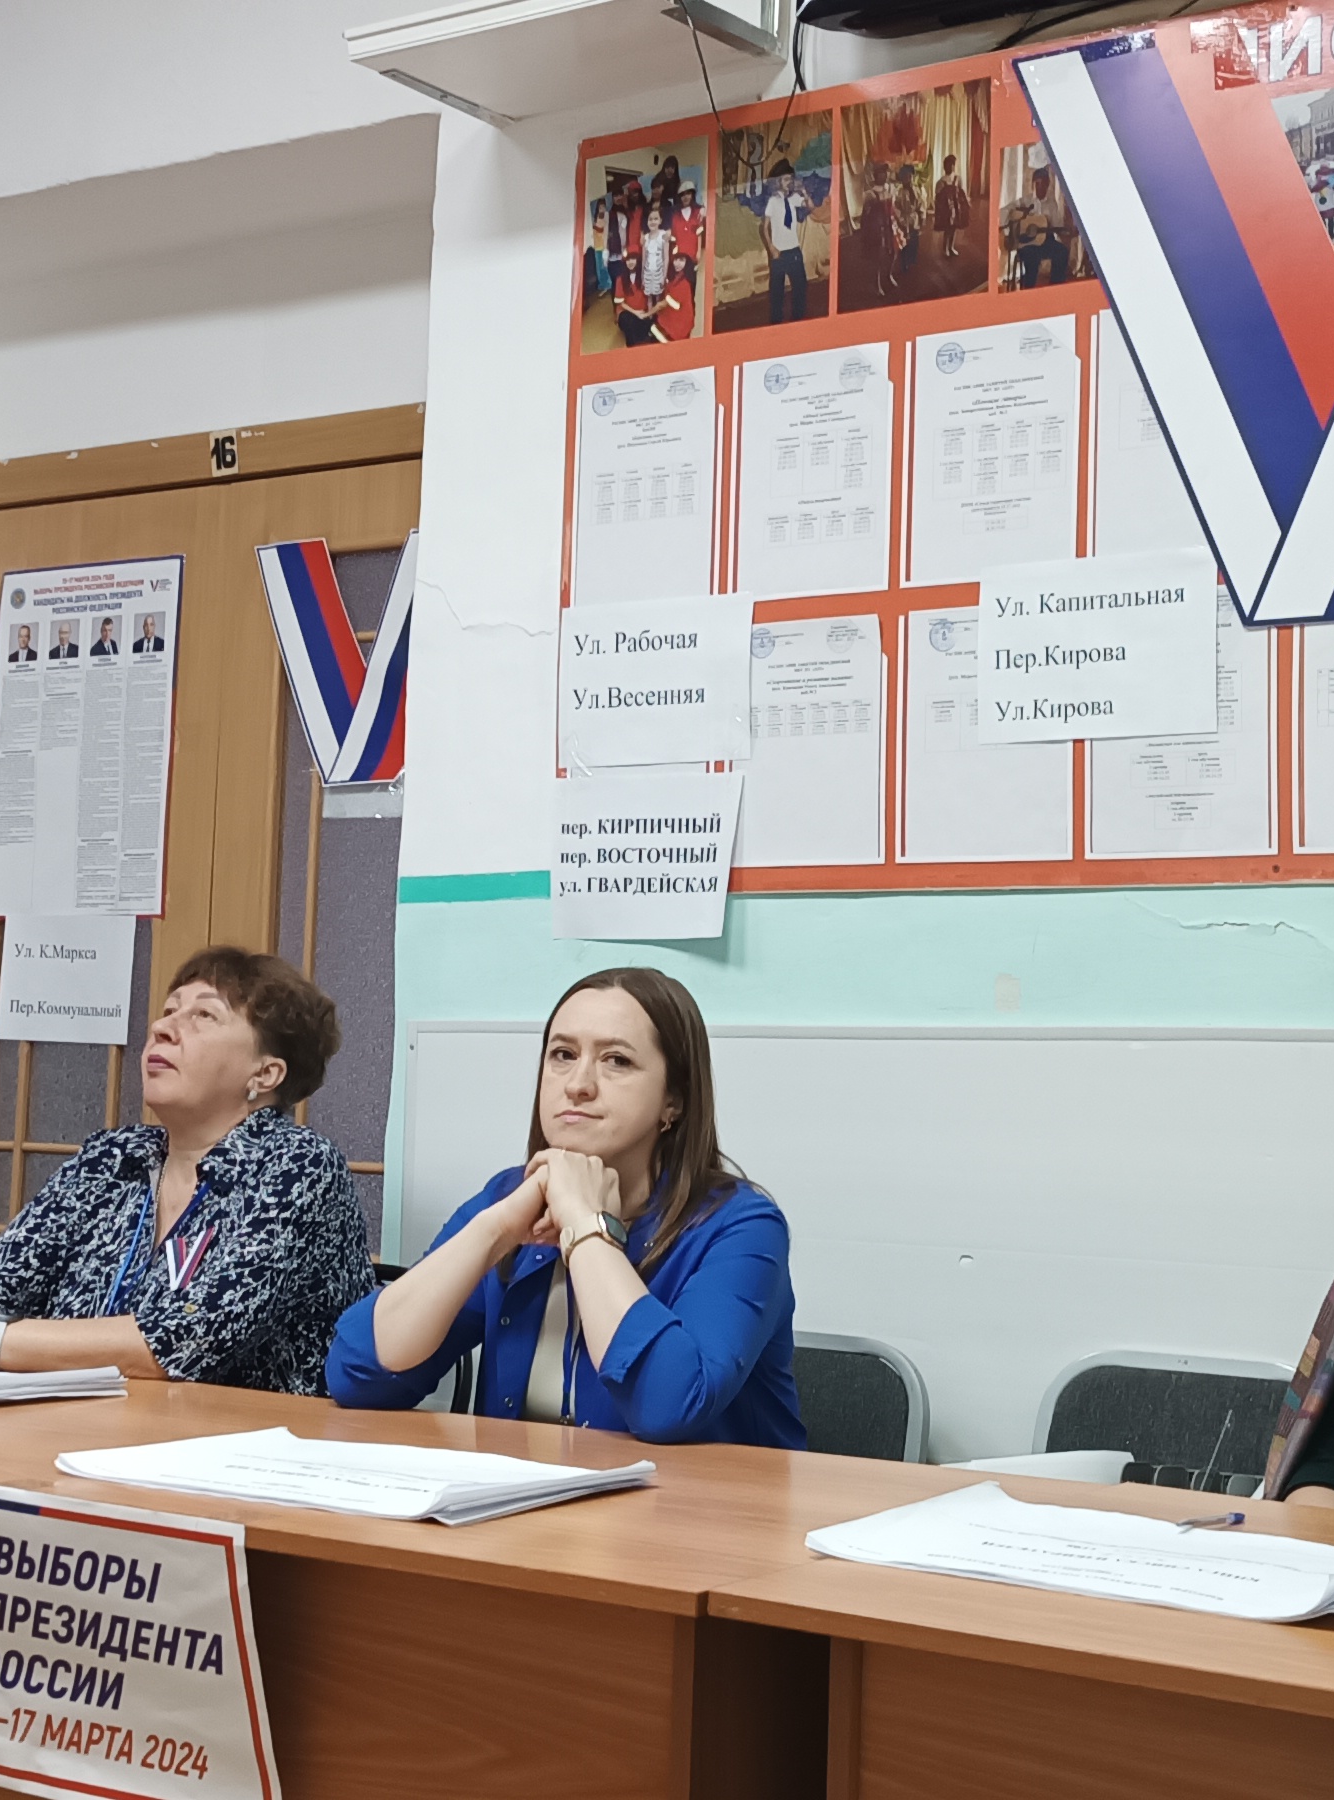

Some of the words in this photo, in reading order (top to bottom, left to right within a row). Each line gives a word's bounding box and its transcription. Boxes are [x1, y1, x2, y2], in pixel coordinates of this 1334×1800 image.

[211, 435, 237, 471] 16
[995, 596, 1030, 618] Ул.
[1038, 587, 1186, 614] Капитальная
[573, 633, 607, 657] Ул.
[613, 629, 699, 654] Рабочая
[994, 645, 1127, 674] Пер.Кирова
[572, 686, 706, 710] Ул.Весенняя
[994, 699, 1115, 724] Ул.Кирова
[560, 822, 593, 839] пер.
[597, 813, 722, 834] КИРПИЧНЫЙ
[560, 850, 592, 868] пер.
[596, 843, 718, 864] ВОСТОЧНЫЙ
[559, 880, 583, 897] ул.
[586, 873, 719, 894] ГВАРДЕЙСКАЯ
[14, 943, 35, 958] Ул.
[39, 944, 97, 963] К.Маркса
[9, 999, 122, 1019] Пер.Коммунальный
[40, 1714, 134, 1765] МАРТА
[140, 1734, 209, 1780] 2024
